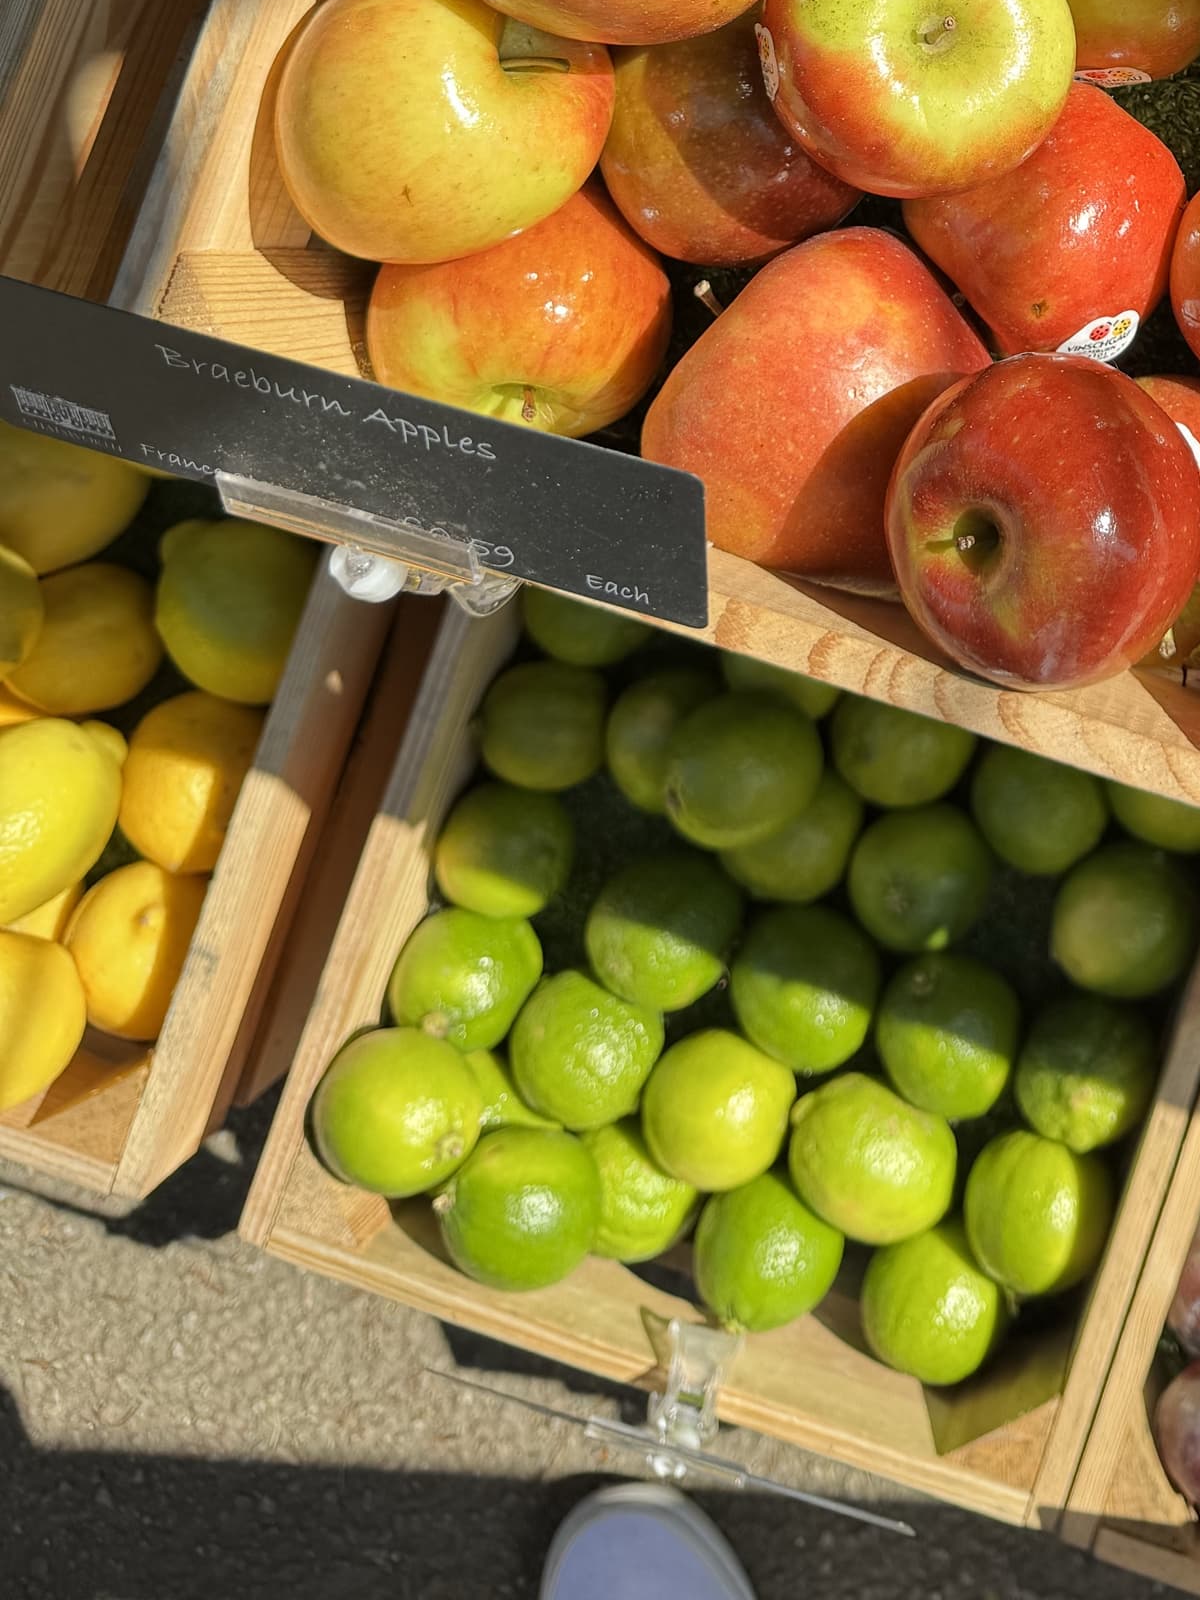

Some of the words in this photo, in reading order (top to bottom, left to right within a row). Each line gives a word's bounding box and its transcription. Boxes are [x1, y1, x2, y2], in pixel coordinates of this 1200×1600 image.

[155, 344, 351, 415] Braeburn
[363, 409, 496, 460] Apples
[585, 574, 649, 605] Each
